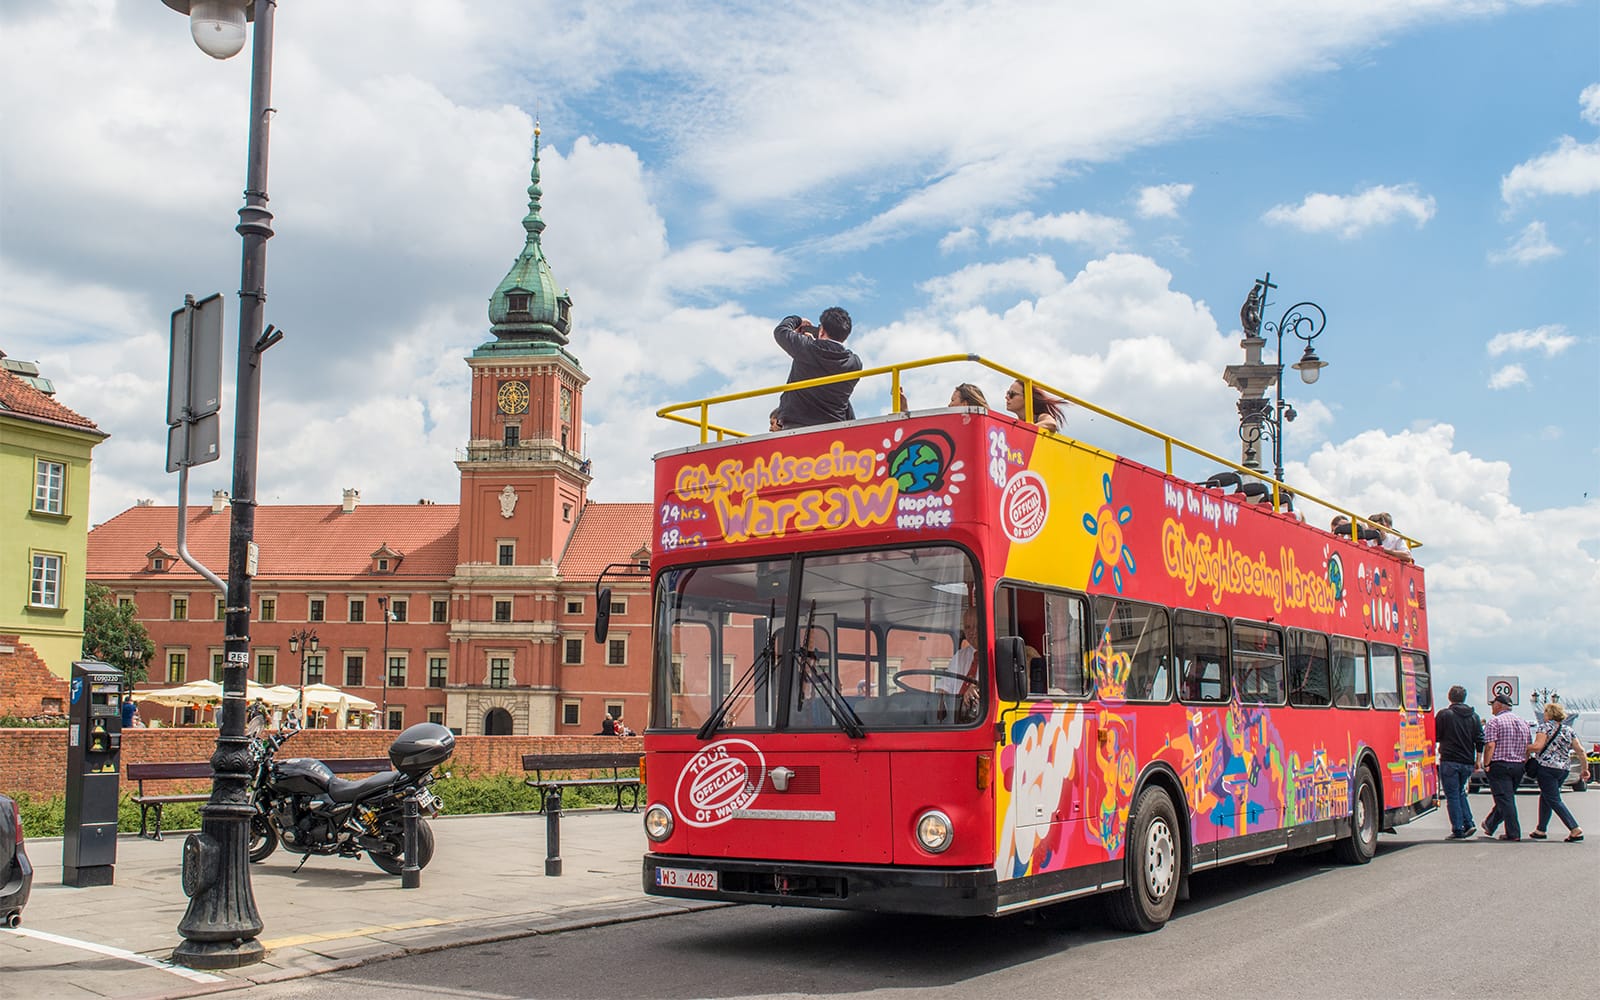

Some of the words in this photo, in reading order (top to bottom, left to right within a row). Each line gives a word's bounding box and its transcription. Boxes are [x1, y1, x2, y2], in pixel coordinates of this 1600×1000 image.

[990, 431, 1008, 457] 24
[990, 457, 1006, 488] 48
[1009, 476, 1027, 495] TOUR
[713, 477, 899, 543] Warsaw
[1013, 494, 1039, 521] OFFICIAL
[1165, 483, 1184, 517] Hop
[1187, 489, 1200, 515] On
[1202, 495, 1221, 529] Hop
[1280, 545, 1337, 614] Warsaw
[1496, 685, 1510, 695] 20
[690, 745, 729, 775] TOUR
[696, 768, 740, 802] OFFICIAL
[695, 810, 711, 822] OF
[715, 781, 755, 818] WARSAW
[662, 870, 676, 884] W3
[686, 872, 714, 888] 4482
